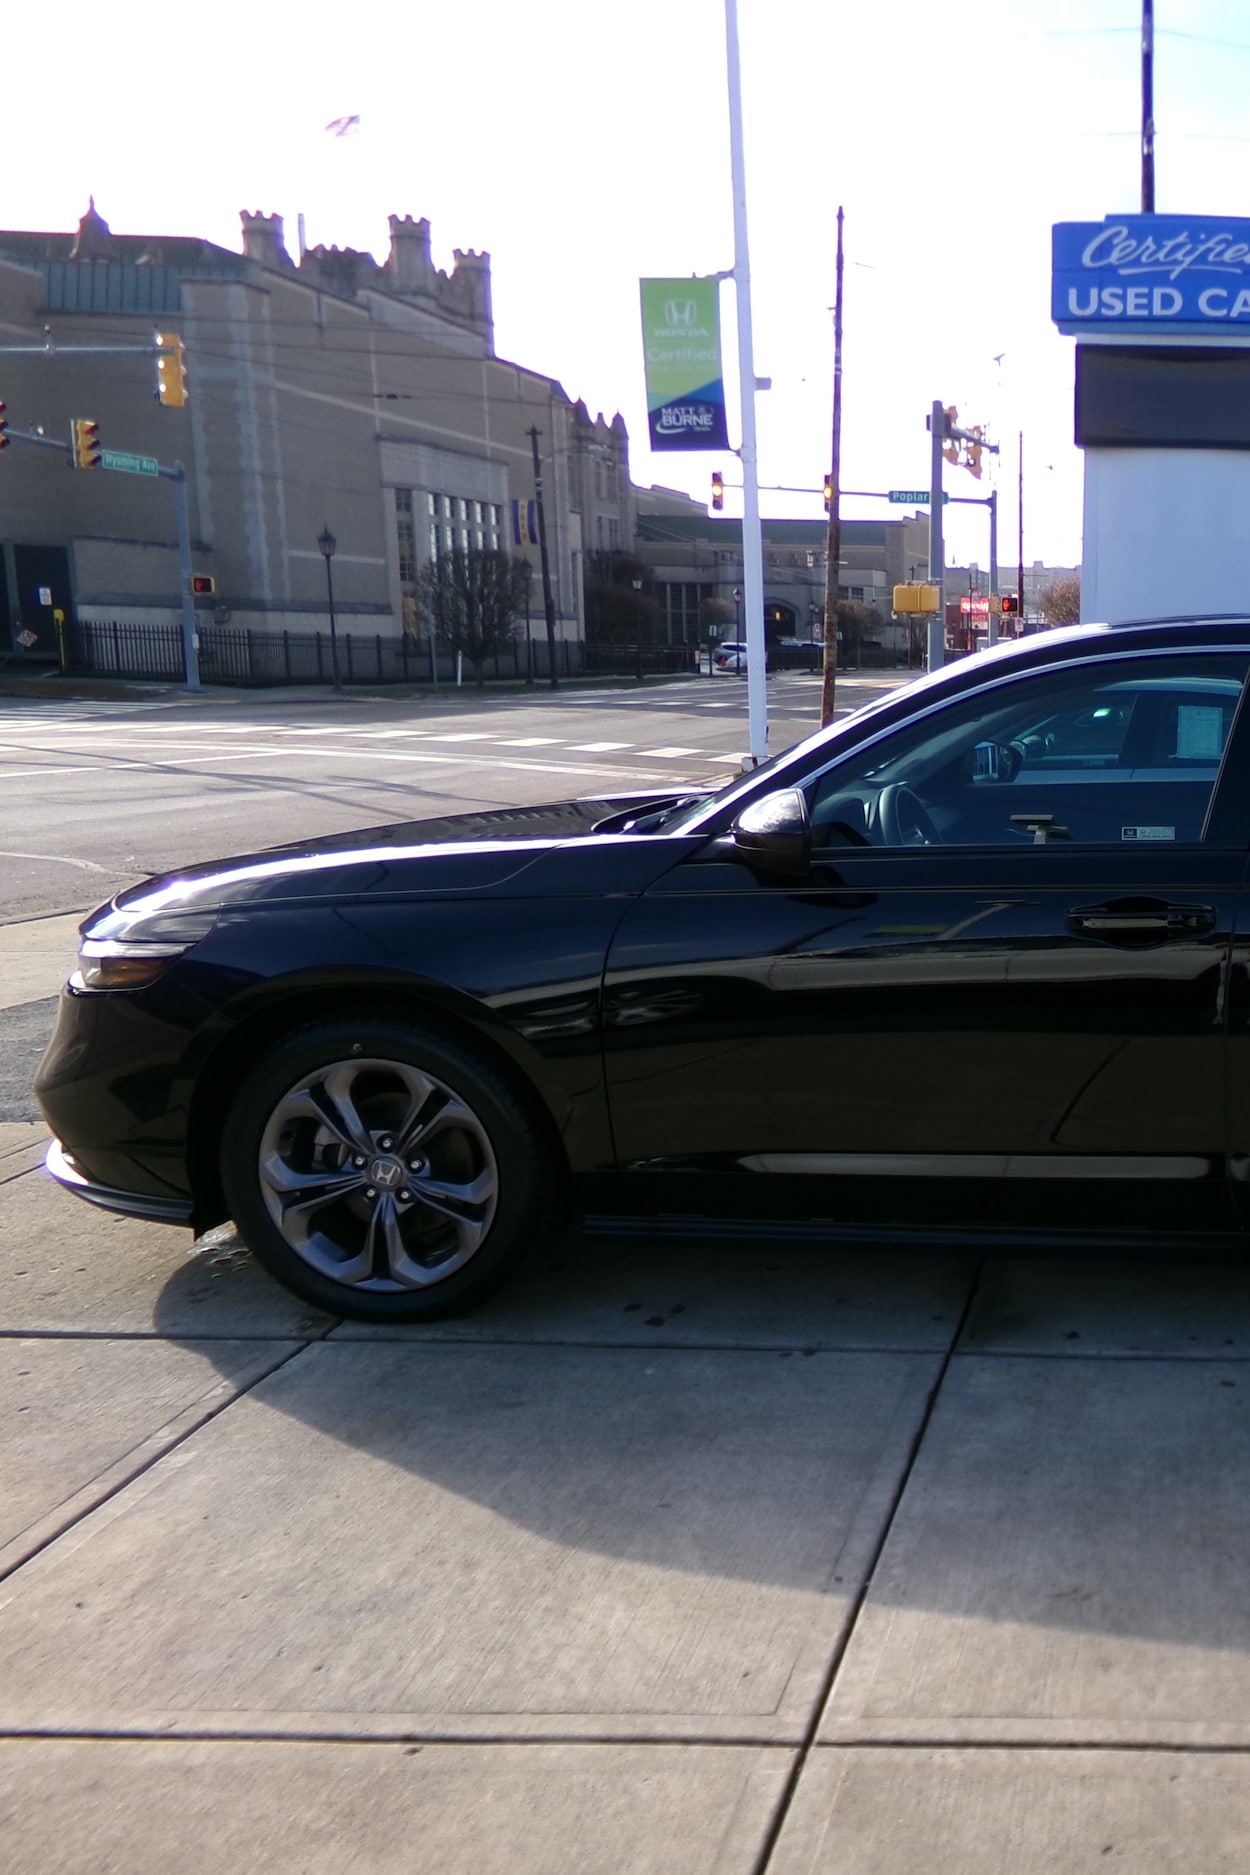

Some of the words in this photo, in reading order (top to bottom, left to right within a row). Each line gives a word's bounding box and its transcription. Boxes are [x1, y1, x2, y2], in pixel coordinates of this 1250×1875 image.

[1068, 287, 1183, 316] USED
[662, 407, 695, 416] MATT
[662, 414, 713, 426] BURNE
[104, 452, 140, 471] Wyoming
[143, 459, 156, 472] Ave
[892, 491, 928, 502] Poplar
